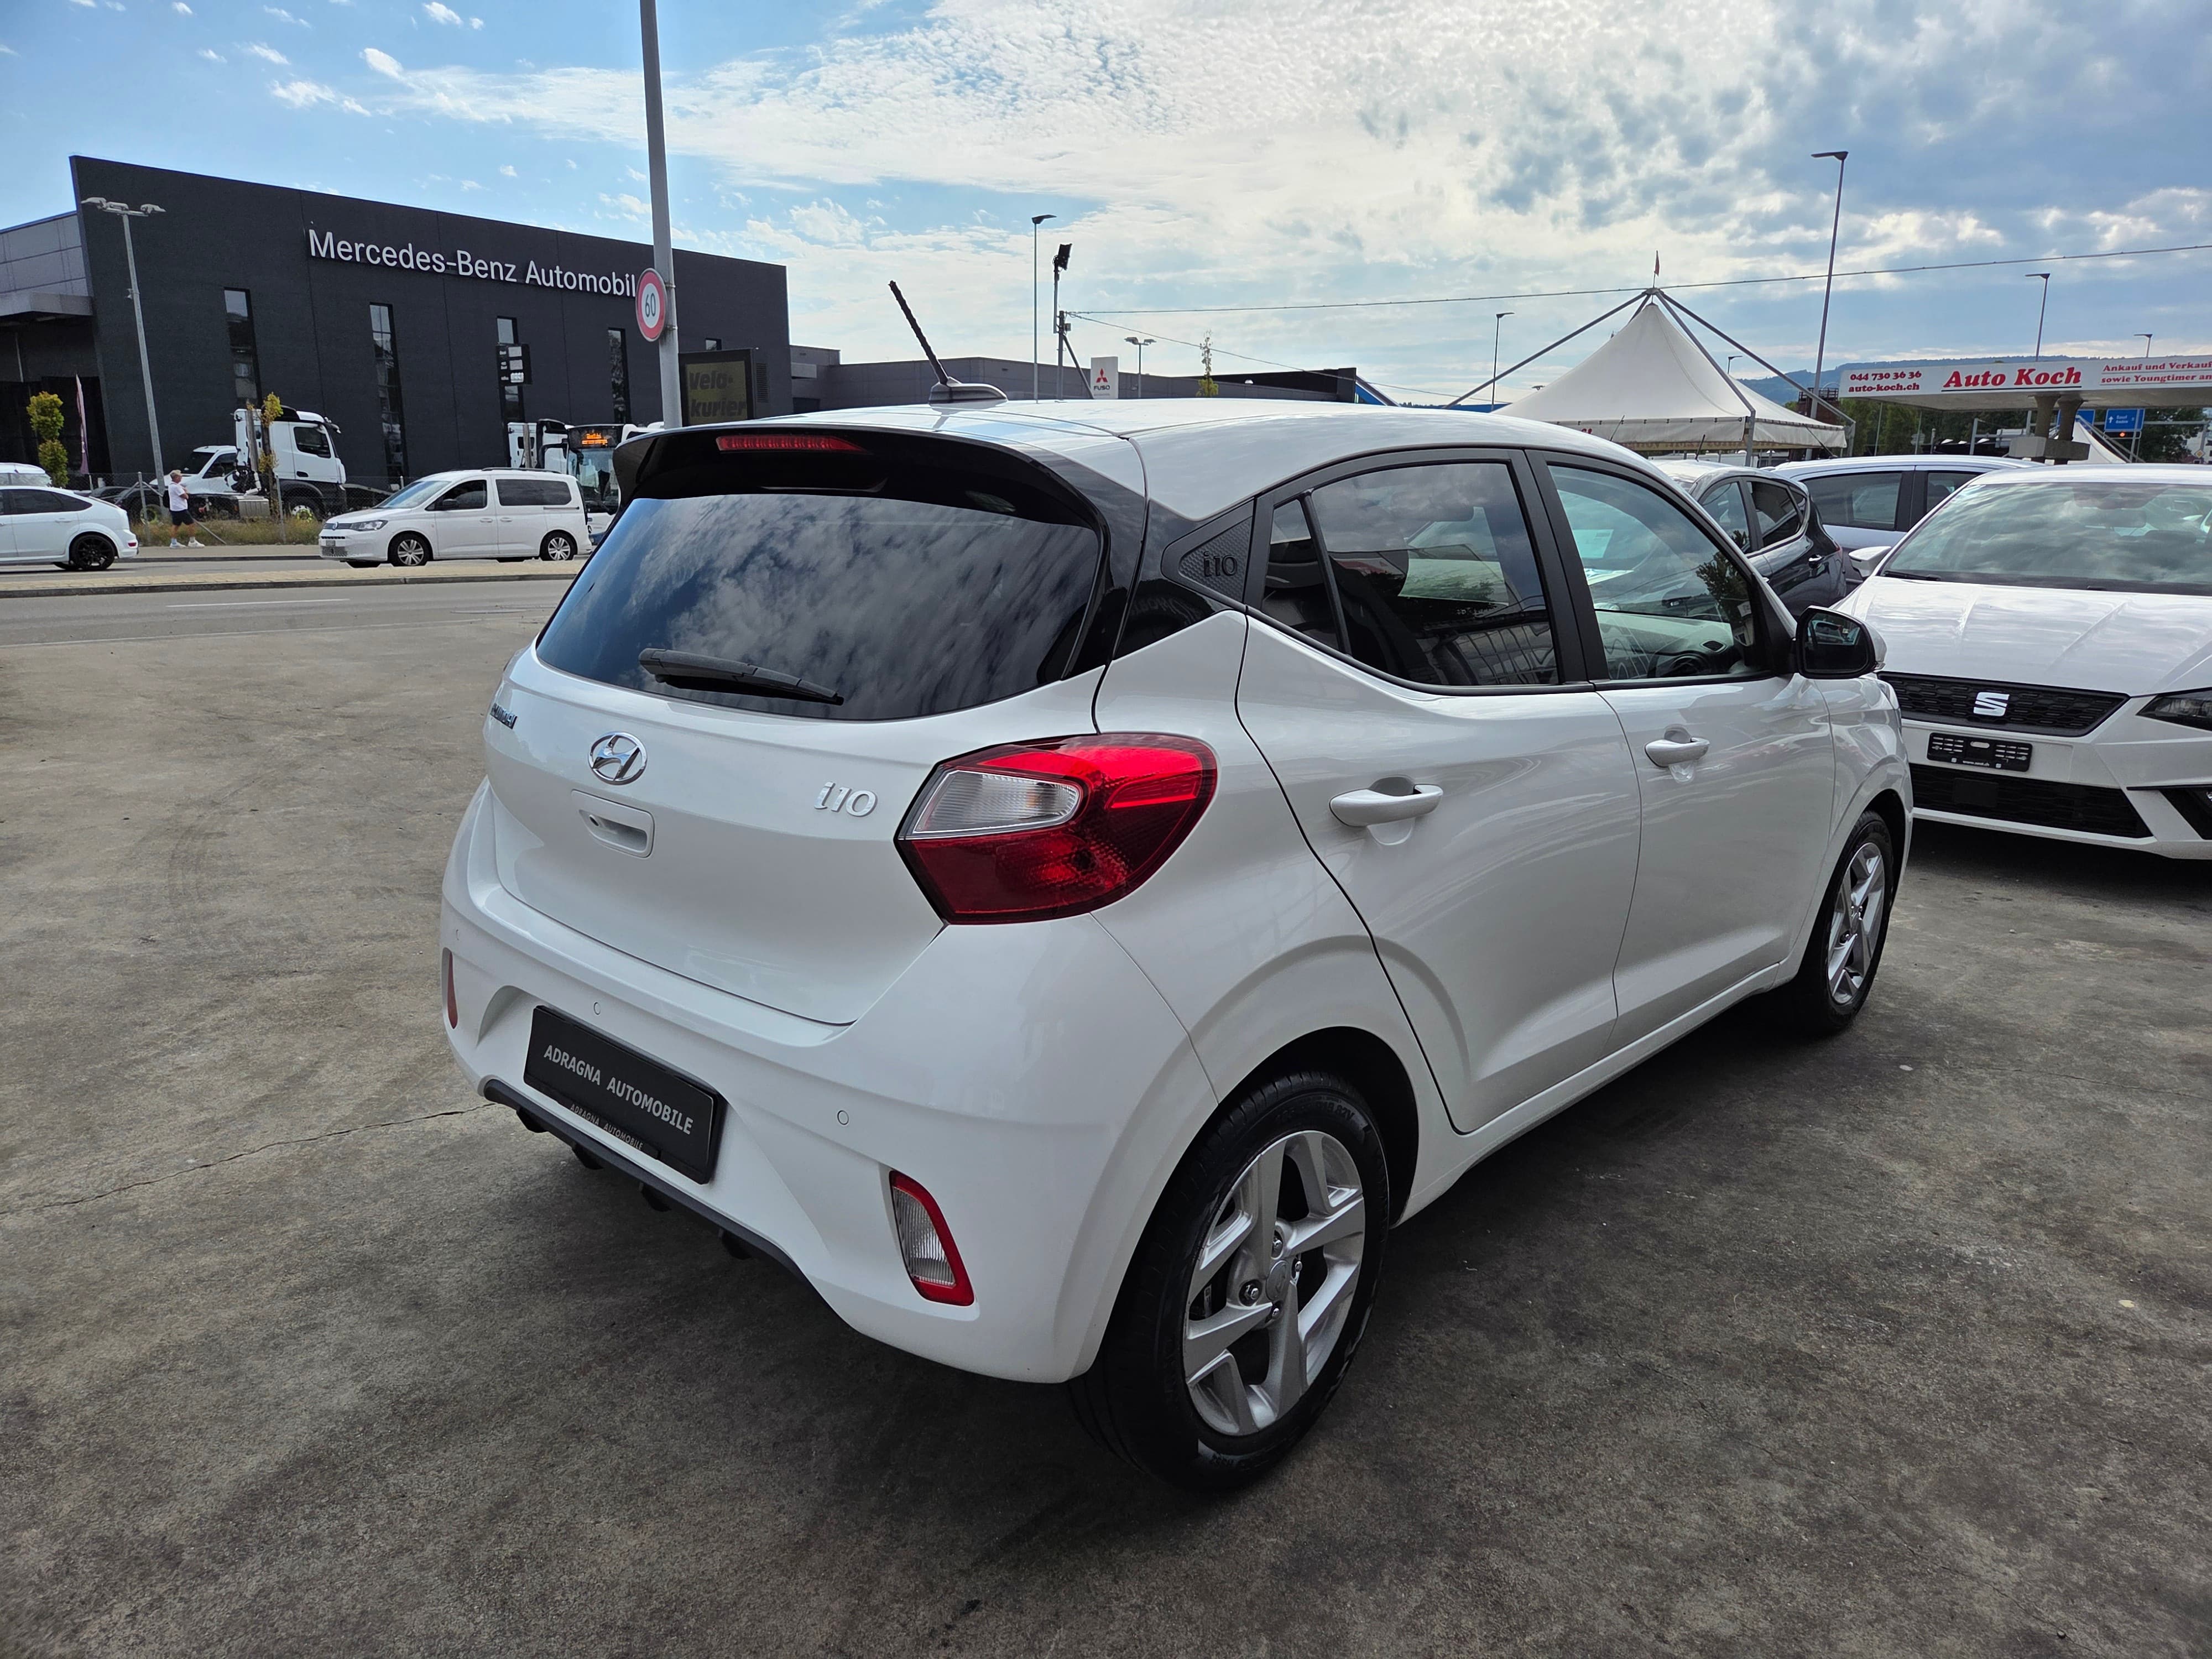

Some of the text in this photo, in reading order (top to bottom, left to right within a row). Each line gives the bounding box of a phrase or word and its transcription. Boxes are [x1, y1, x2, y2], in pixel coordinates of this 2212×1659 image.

[309, 229, 636, 297] Mercedes-Benz Automobil
[645, 293, 656, 317] 60
[1871, 372, 1891, 380] 730
[1892, 371, 1906, 380] 36
[1908, 371, 1922, 379] 36
[2169, 361, 2212, 369] Verkauf
[1849, 383, 1920, 392] auto-koch.ch
[1943, 367, 2081, 388] Auto Koch
[2134, 374, 2197, 383] Youngtimer
[691, 398, 747, 418] kurier
[1203, 551, 1238, 577] i10
[814, 781, 878, 817] i10
[544, 1045, 693, 1135] ADRAGNA AUTOMOBILE
[570, 1104, 644, 1151] ADRAGNA AUTOMOBILE
